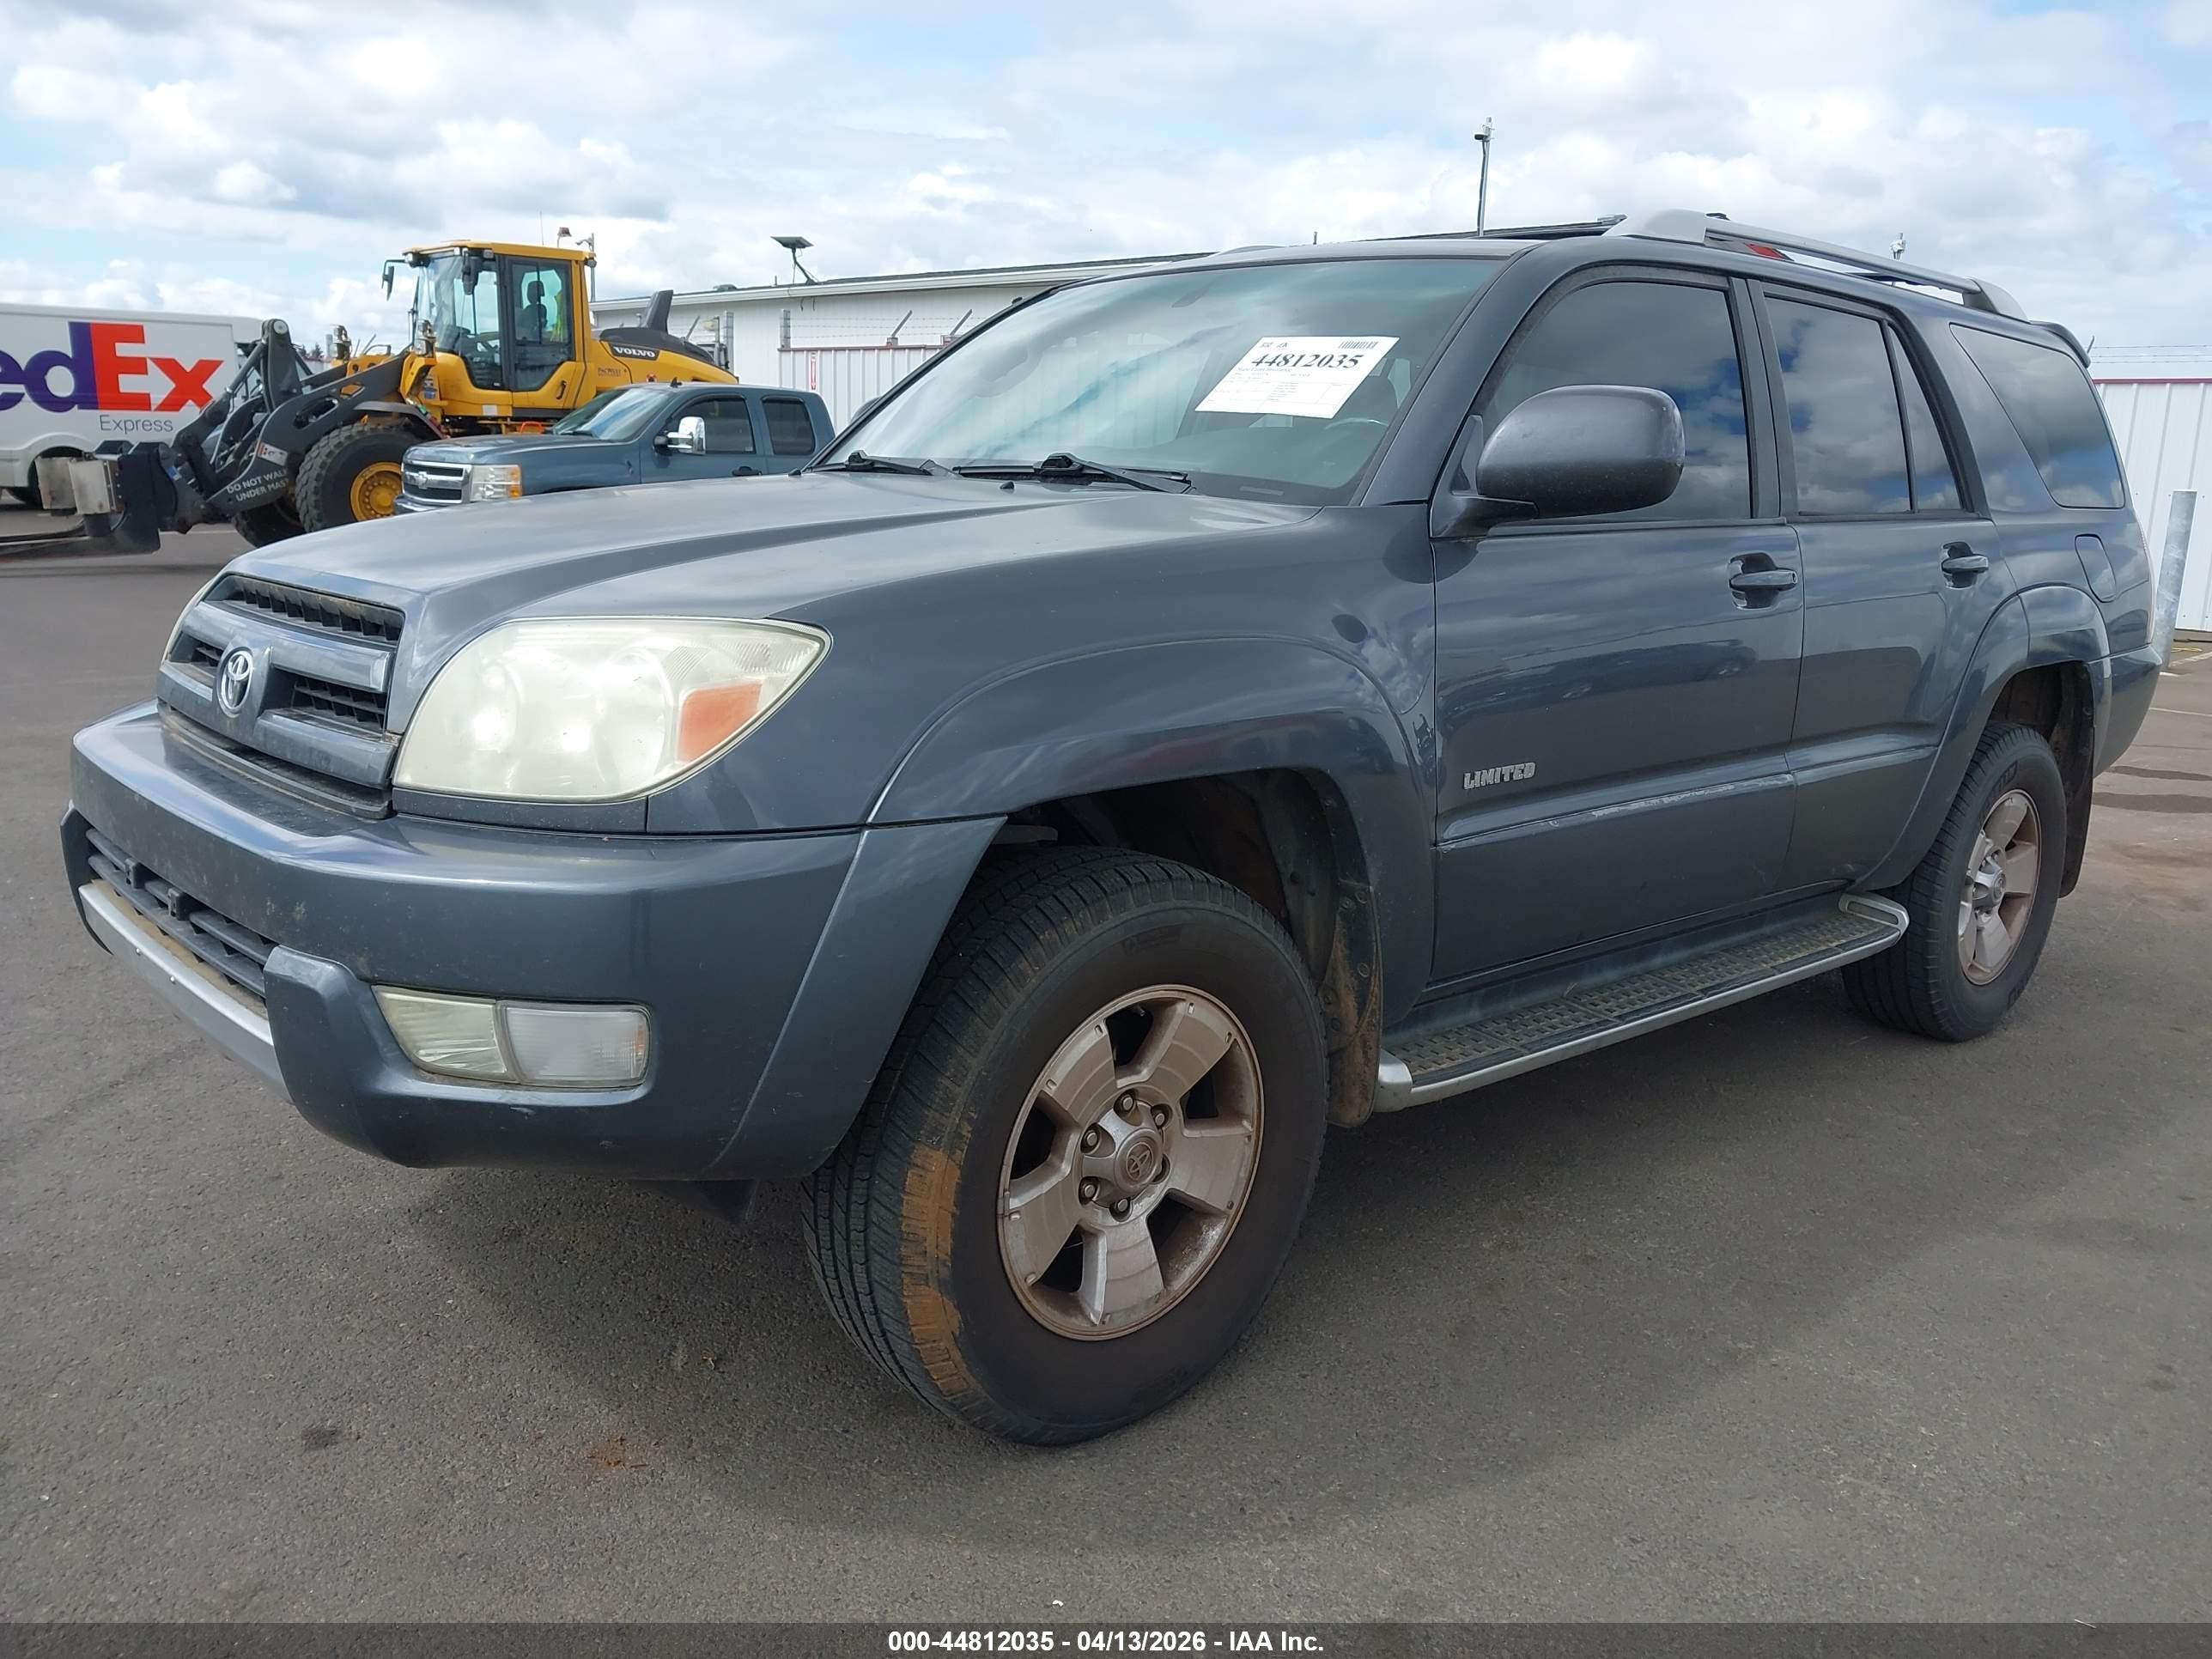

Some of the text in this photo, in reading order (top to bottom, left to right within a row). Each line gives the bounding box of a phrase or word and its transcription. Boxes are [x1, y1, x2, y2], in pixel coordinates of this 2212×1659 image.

[613, 346, 655, 358] VOLVO
[1251, 353, 1364, 368] 44812035
[99, 415, 173, 434] Express
[242, 477, 261, 489] NOT
[236, 486, 267, 501] UNDER
[1463, 762, 1535, 790] LIMITED
